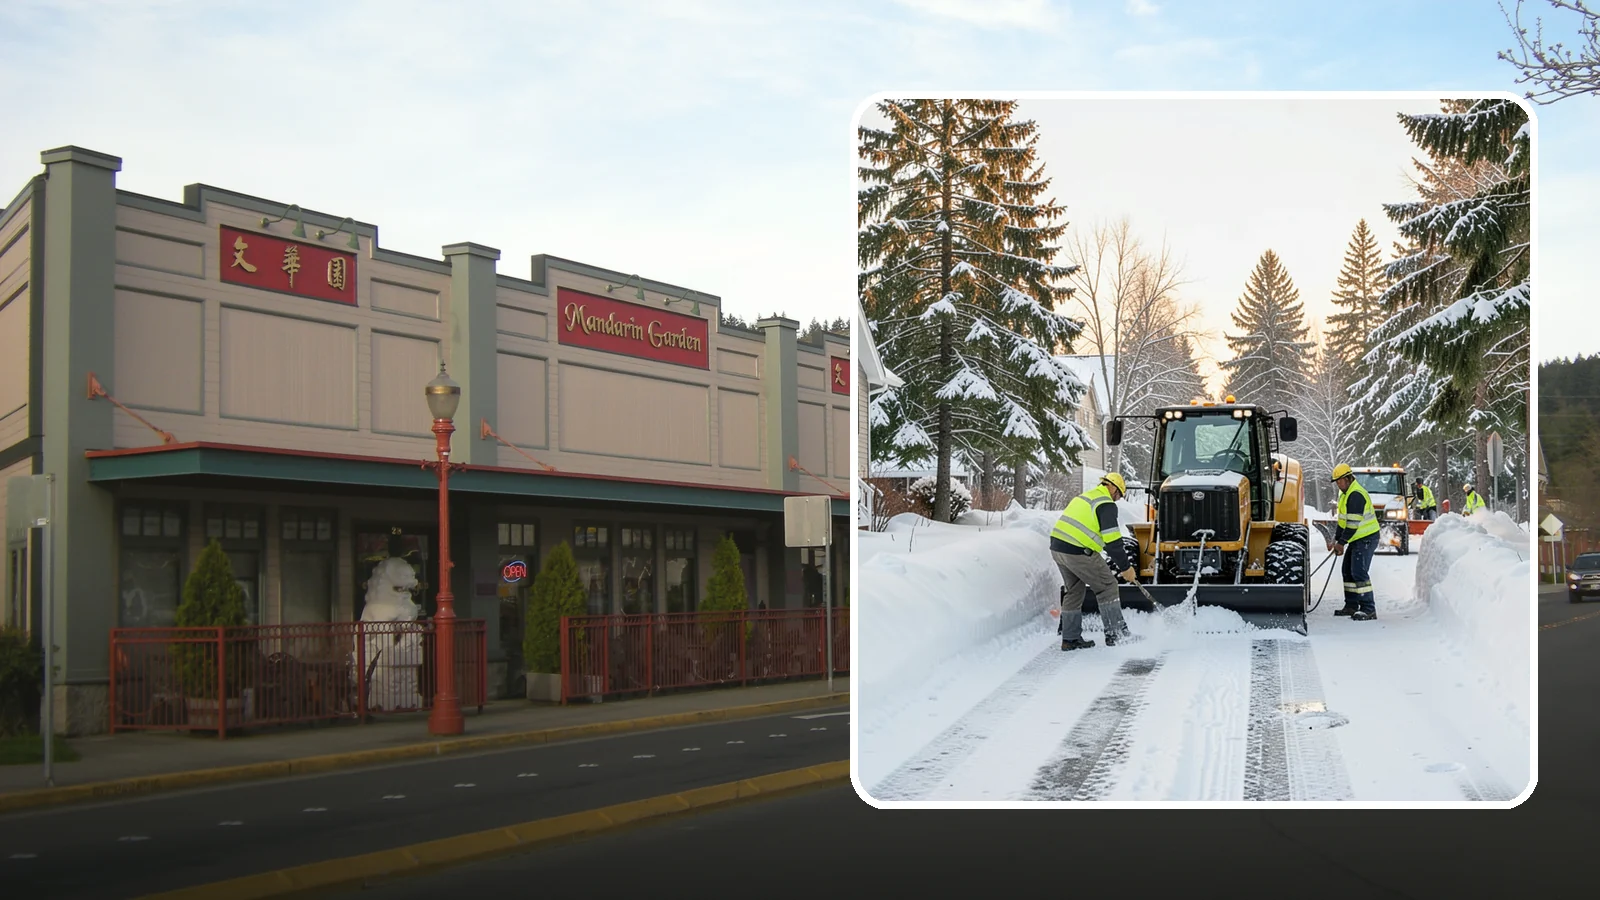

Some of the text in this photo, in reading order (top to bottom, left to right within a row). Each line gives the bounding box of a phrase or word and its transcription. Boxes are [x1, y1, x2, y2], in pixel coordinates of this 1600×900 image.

[231, 236, 346, 290] 文華園
[565, 302, 701, 352] Mandarin Garden
[503, 565, 527, 578] OPEN
